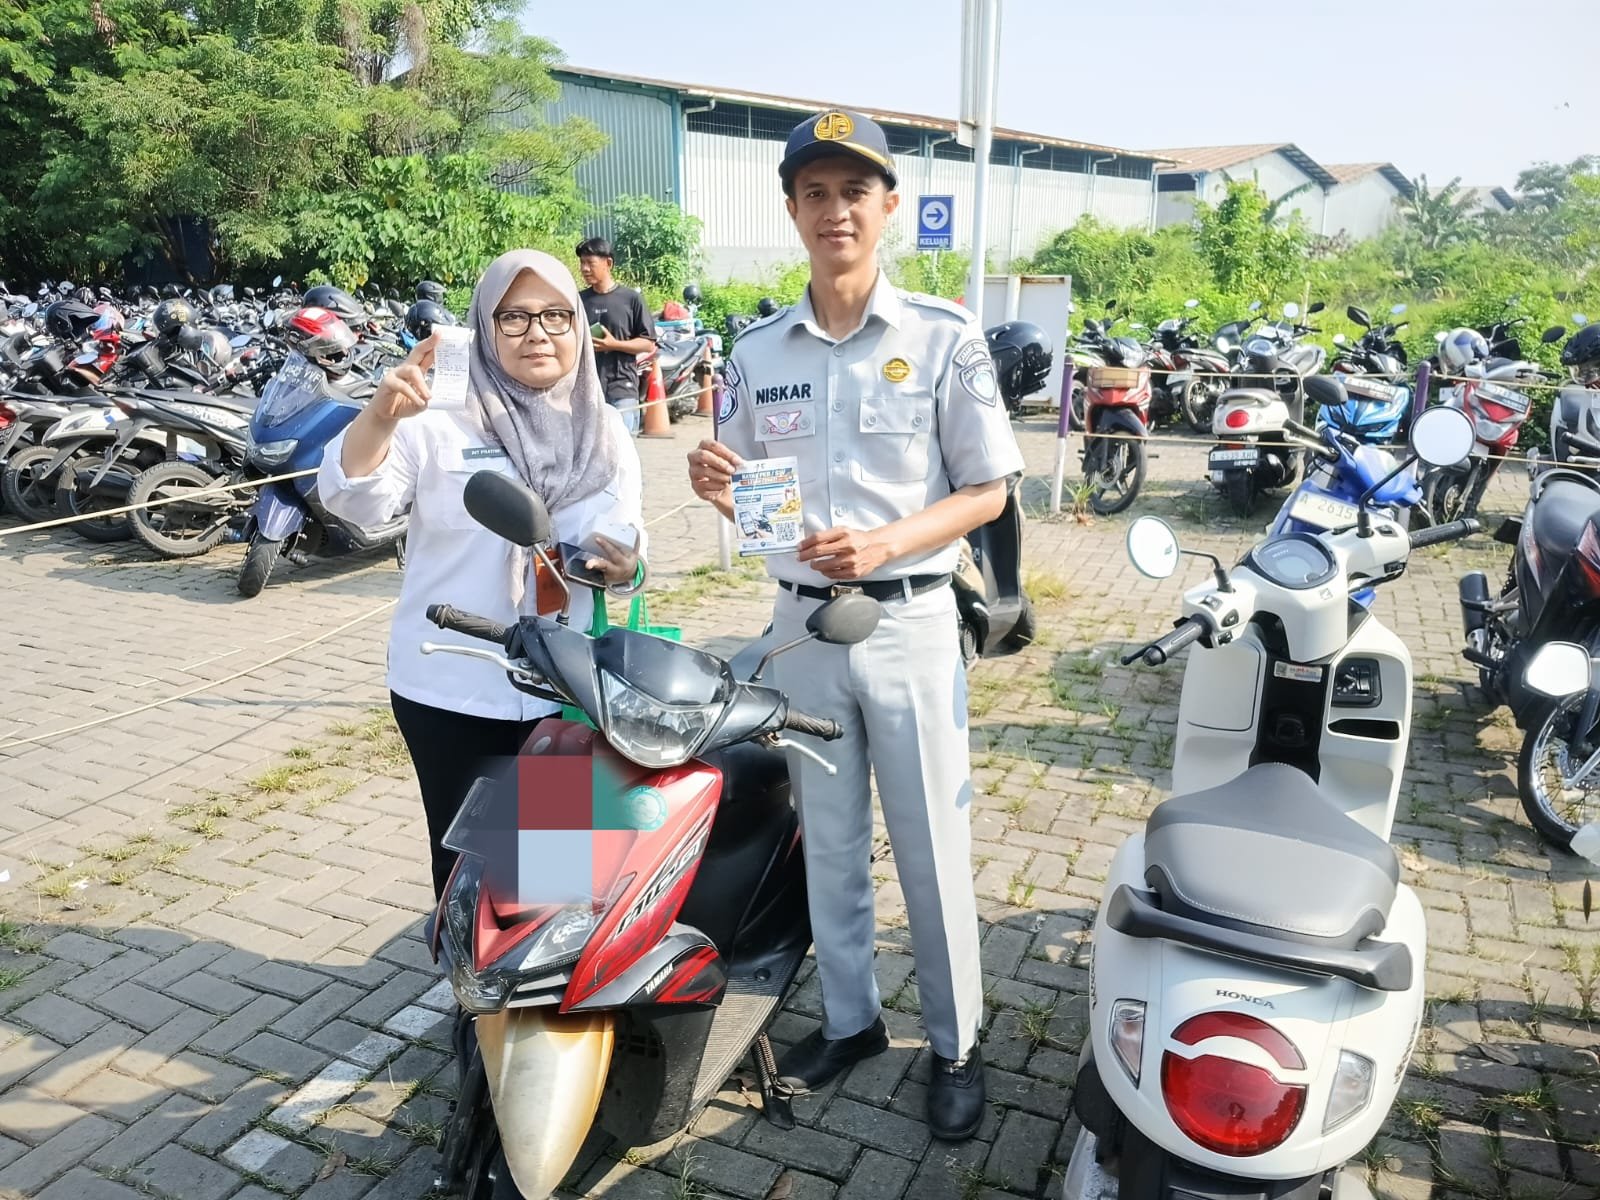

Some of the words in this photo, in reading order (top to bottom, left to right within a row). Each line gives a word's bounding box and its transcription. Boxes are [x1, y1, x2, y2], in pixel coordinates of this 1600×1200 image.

[919, 237, 949, 246] KELUAR
[756, 383, 811, 405] NISKAR
[1299, 492, 1309, 504] A
[1317, 500, 1354, 520] 2615
[645, 962, 673, 995] YAMAHA
[1216, 989, 1275, 1010] HONDA
